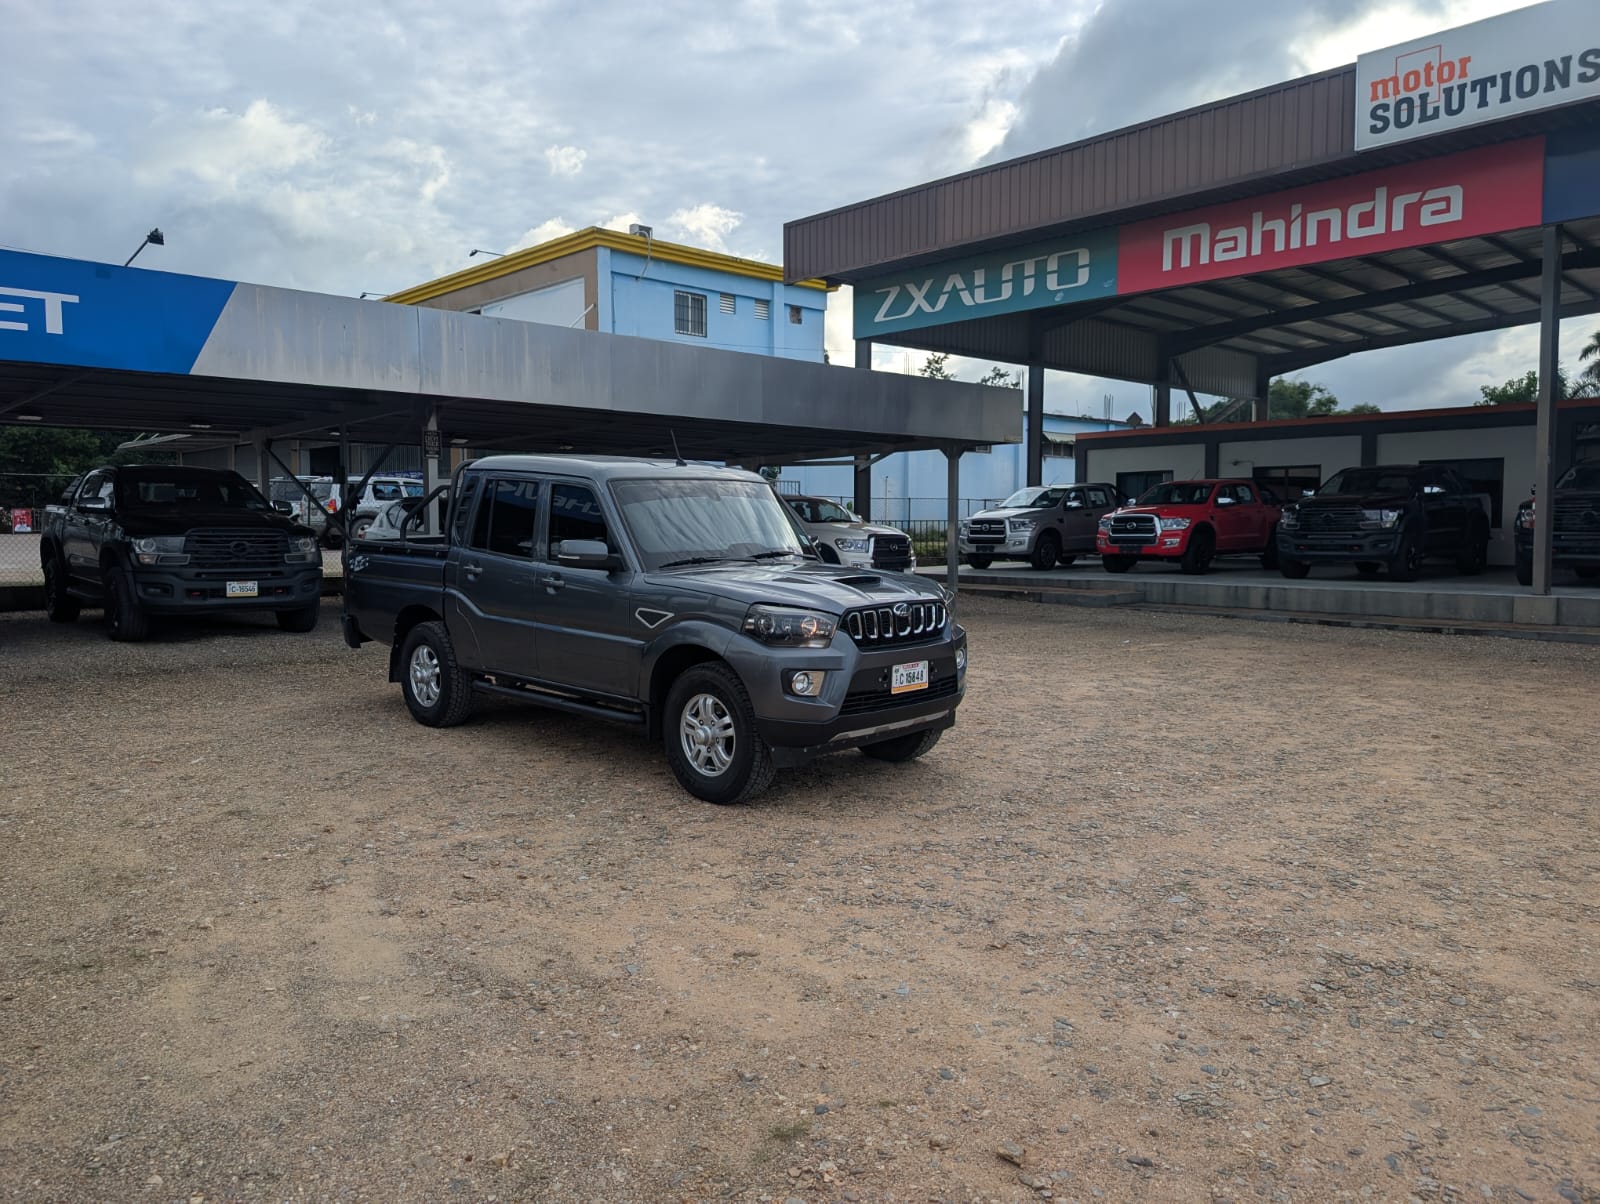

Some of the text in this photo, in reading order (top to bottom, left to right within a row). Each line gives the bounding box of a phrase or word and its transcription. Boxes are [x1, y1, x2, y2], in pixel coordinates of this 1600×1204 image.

[1369, 48, 1600, 135] SOLUTIONS
[1370, 56, 1472, 102] motor
[1162, 184, 1463, 272] Mahindra
[873, 247, 1090, 323] ZXAUTO
